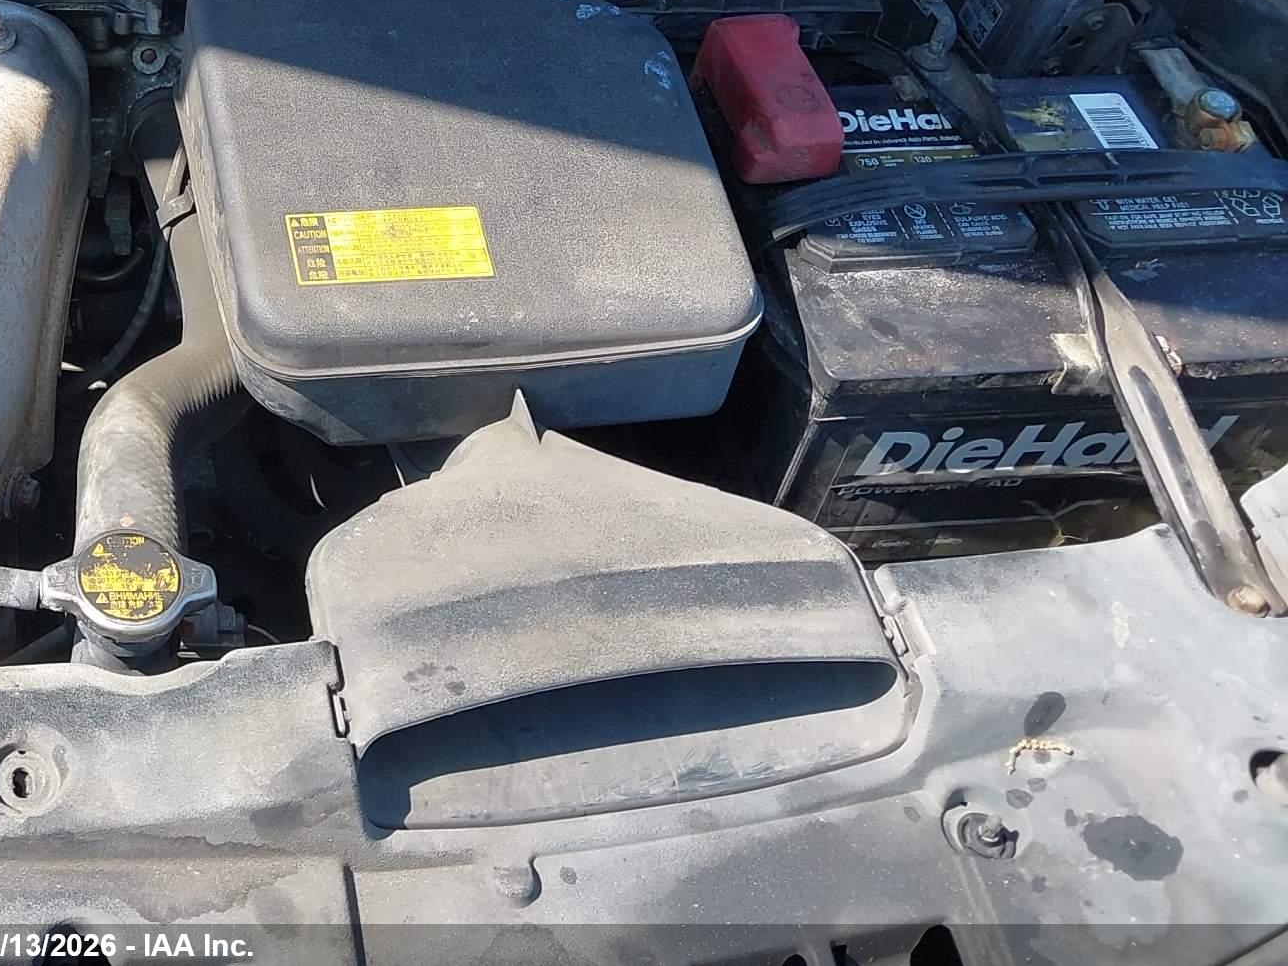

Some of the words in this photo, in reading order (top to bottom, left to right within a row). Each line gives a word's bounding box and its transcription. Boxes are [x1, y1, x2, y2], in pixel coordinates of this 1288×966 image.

[858, 157, 879, 166] 750
[914, 155, 932, 164] 130
[849, 219, 889, 227] EXPLOSIVE
[293, 229, 328, 240] CAUTION
[297, 244, 331, 255] ATTENTION
